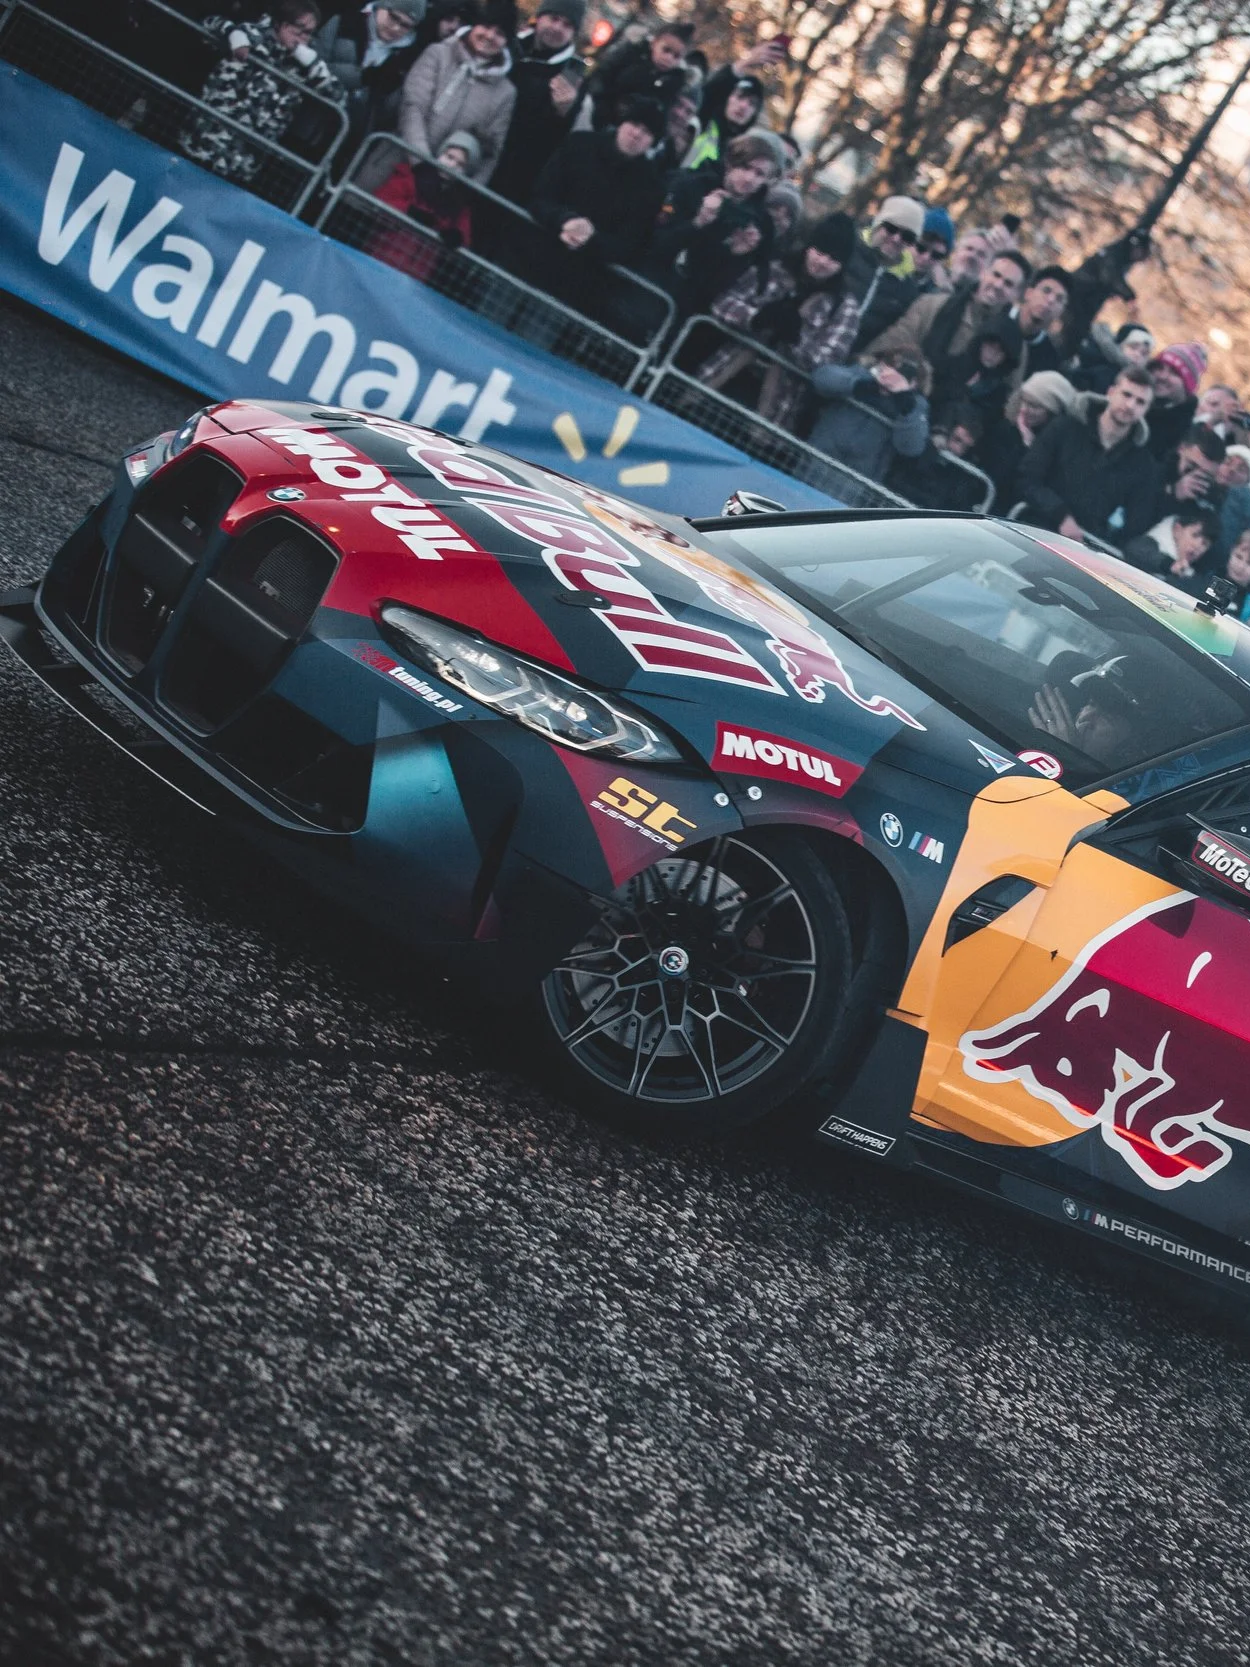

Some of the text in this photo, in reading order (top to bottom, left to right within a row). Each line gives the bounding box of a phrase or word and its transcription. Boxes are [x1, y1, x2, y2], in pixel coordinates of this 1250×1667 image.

[38, 142, 518, 443] Walmart
[256, 428, 478, 561] MOTUL
[721, 731, 841, 787] MOTUL
[918, 835, 944, 863] M
[828, 1121, 888, 1150] DRIFT HAPPENS
